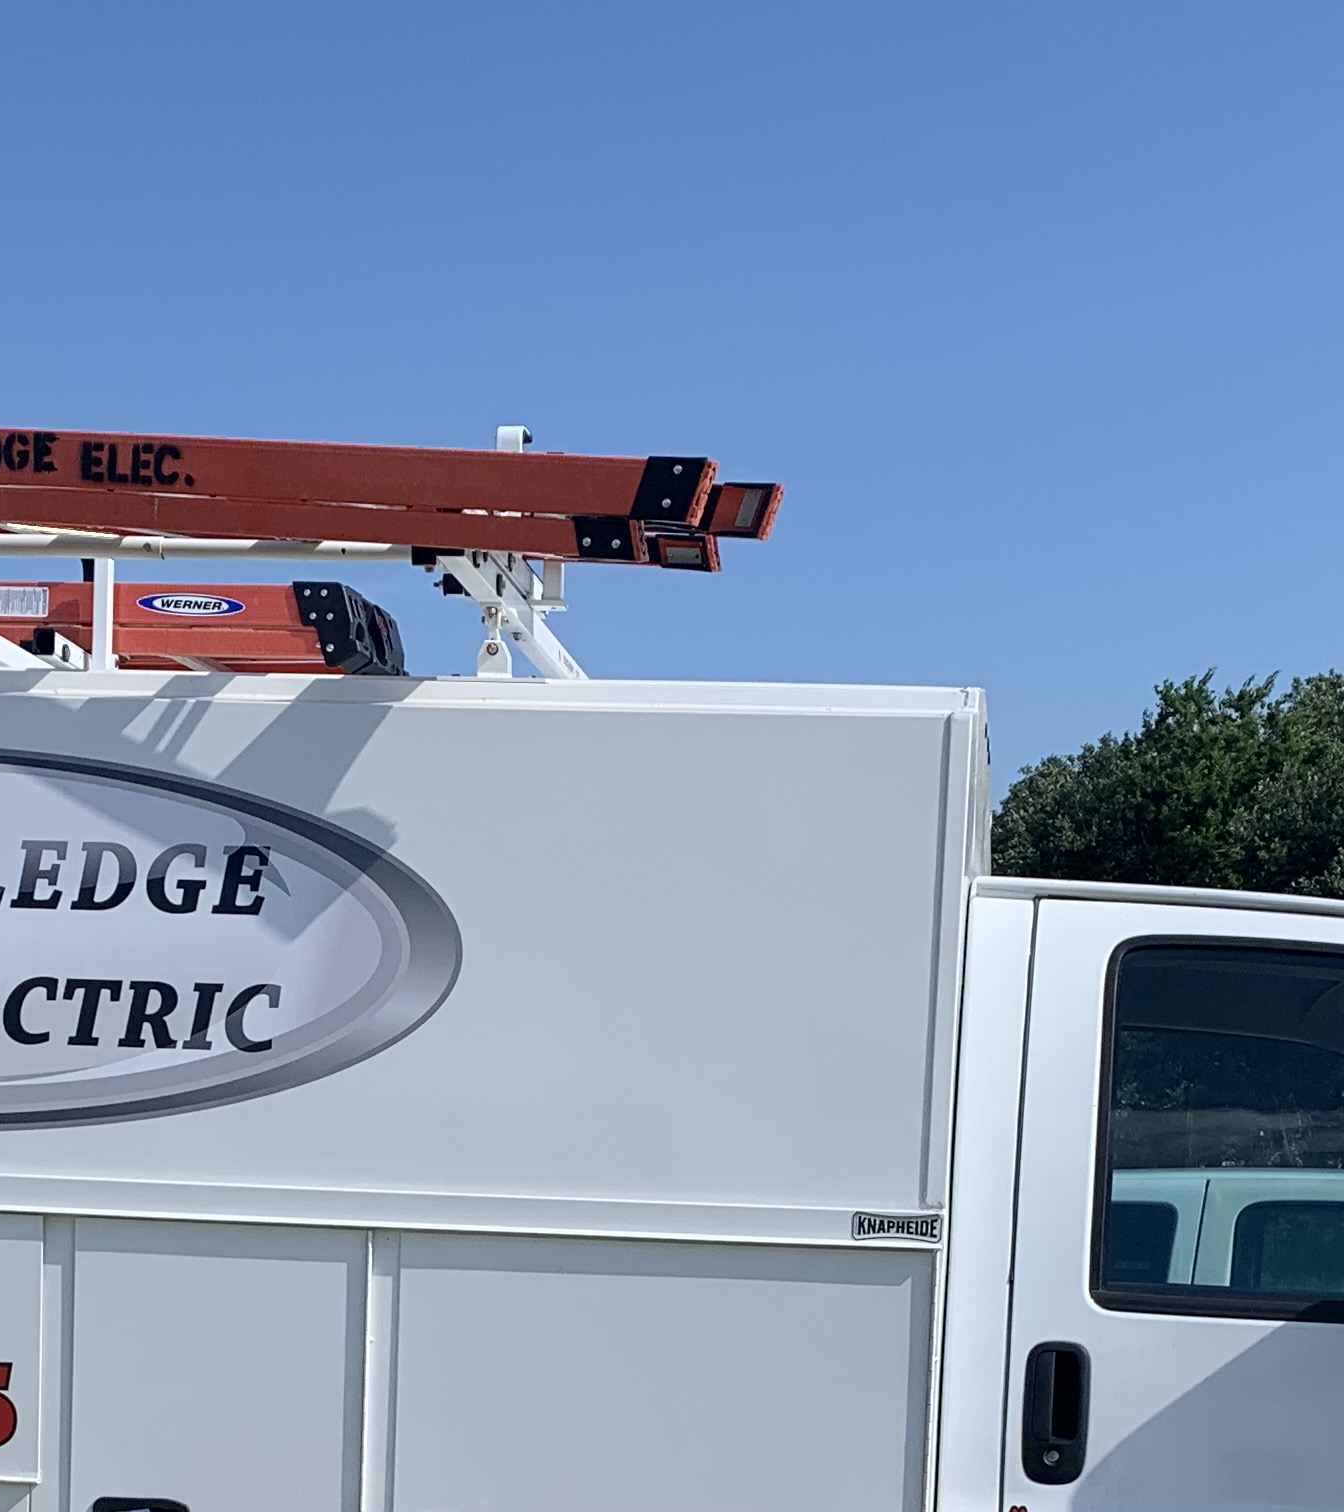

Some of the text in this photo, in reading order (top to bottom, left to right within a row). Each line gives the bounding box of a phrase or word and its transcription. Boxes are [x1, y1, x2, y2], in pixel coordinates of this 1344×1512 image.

[80, 441, 196, 487] ELEC.
[160, 598, 223, 612] WERNER
[857, 1215, 939, 1239] KNAPHEIDE
